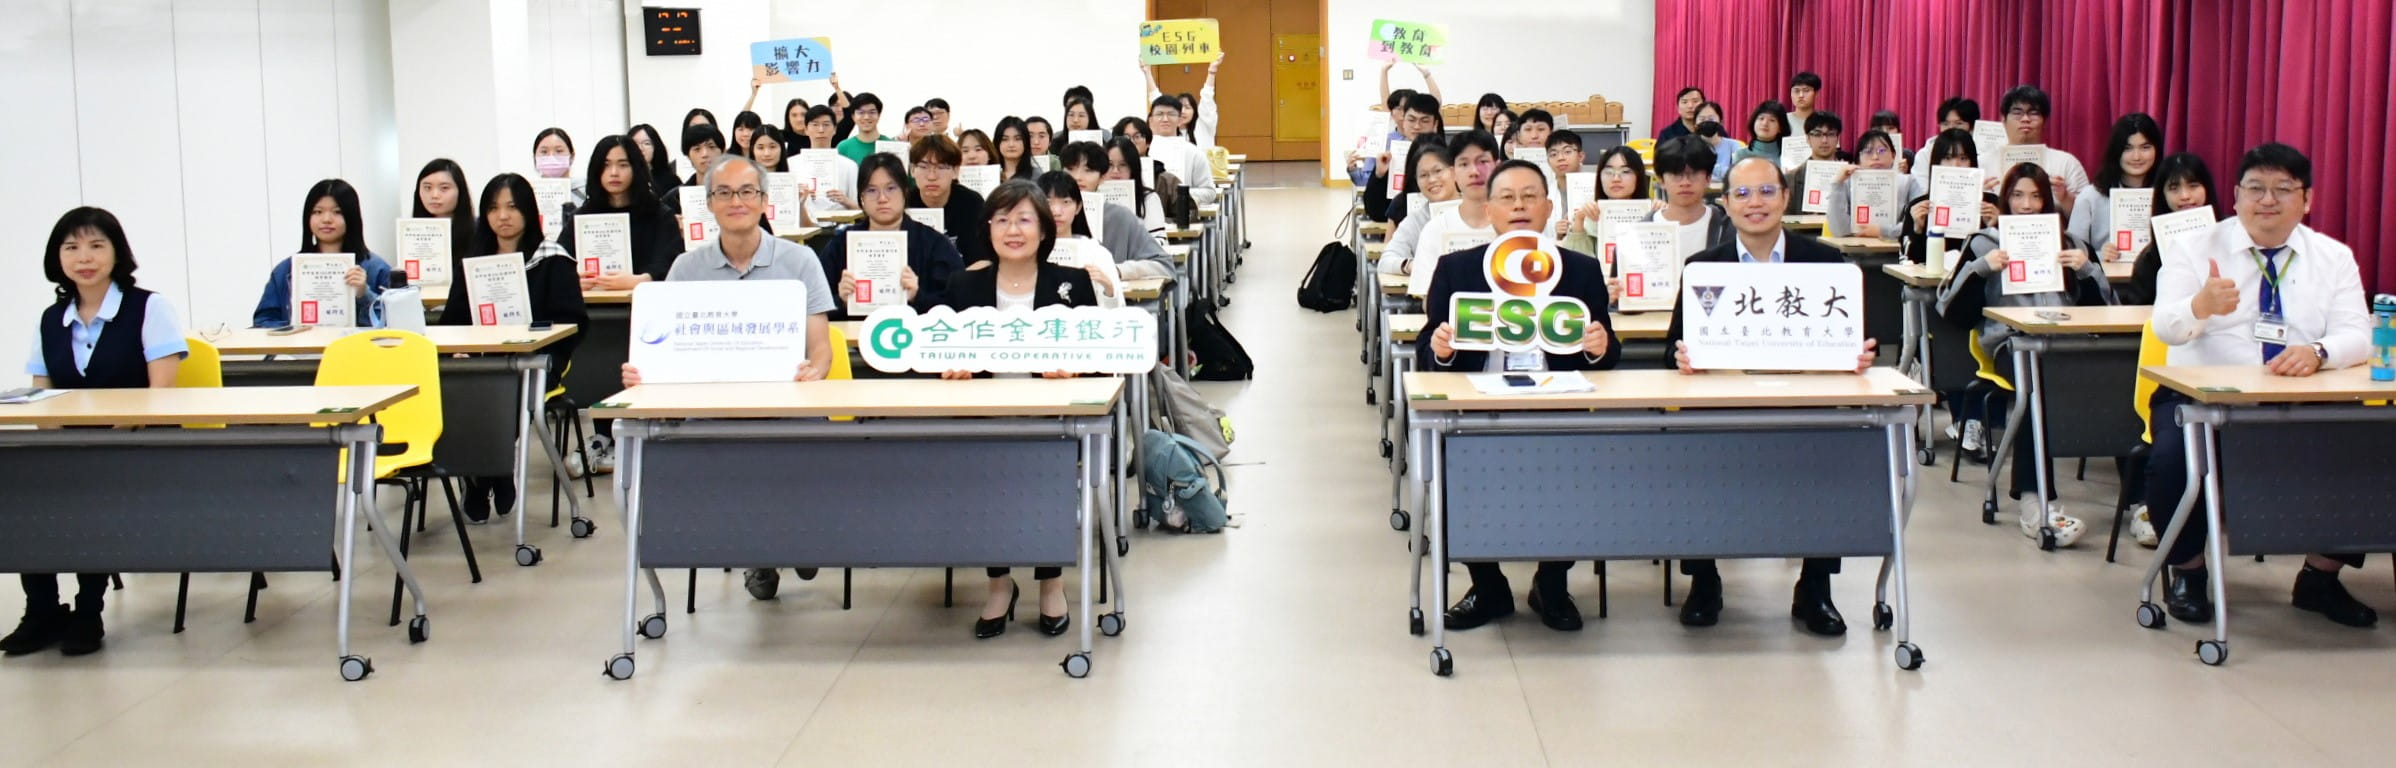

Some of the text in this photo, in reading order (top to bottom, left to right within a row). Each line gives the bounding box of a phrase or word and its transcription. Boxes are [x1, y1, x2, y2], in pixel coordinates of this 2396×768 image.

[1162, 31, 1196, 42] ESG
[774, 44, 810, 60] 擴大
[1149, 42, 1209, 56] 校園列車
[765, 59, 819, 76] 影響力
[1735, 285, 1849, 318] 北教大
[675, 322, 799, 336] 社會與區域發展學系
[1455, 297, 1586, 347] ESG
[921, 318, 1144, 343] 合作金庫銀行
[1699, 326, 1854, 337] 國立臺北教育大學
[920, 352, 976, 360] TAIWAN
[990, 352, 1092, 360] COOPERATIVE
